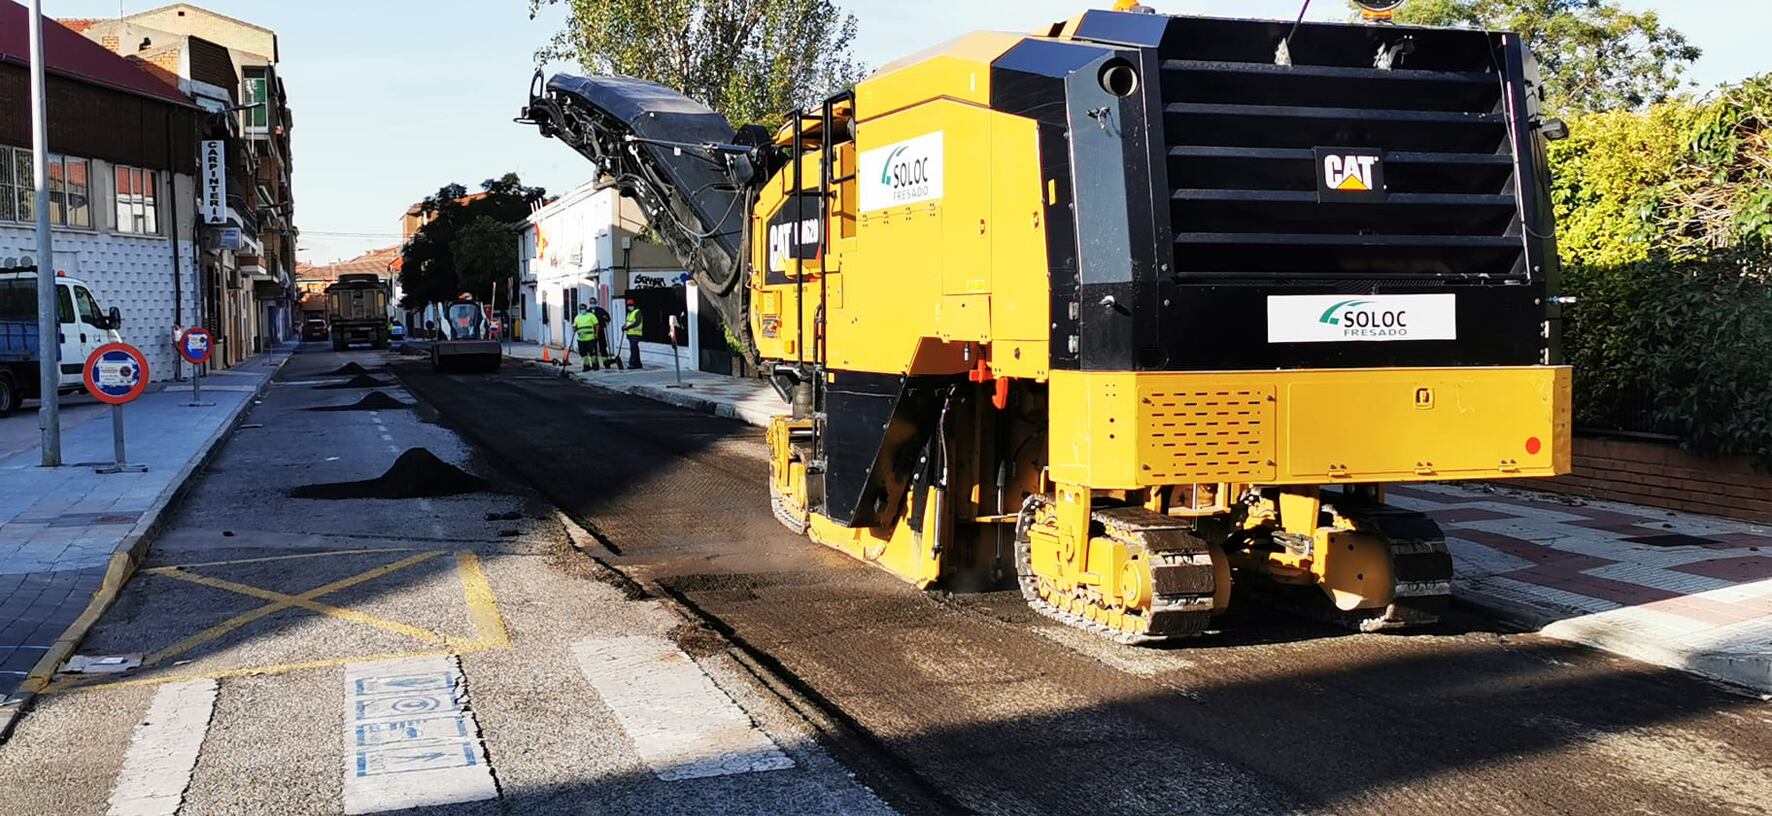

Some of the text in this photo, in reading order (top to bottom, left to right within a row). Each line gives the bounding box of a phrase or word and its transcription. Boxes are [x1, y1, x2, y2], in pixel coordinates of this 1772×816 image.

[207, 141, 220, 223] CARPINTERIA
[893, 156, 928, 189] SOLOC
[1324, 154, 1375, 190] CAT
[893, 185, 929, 201] FRESADO
[770, 218, 819, 272] CAT 620
[1344, 311, 1407, 328] SOLOC
[1344, 329, 1407, 337] FRESADO
